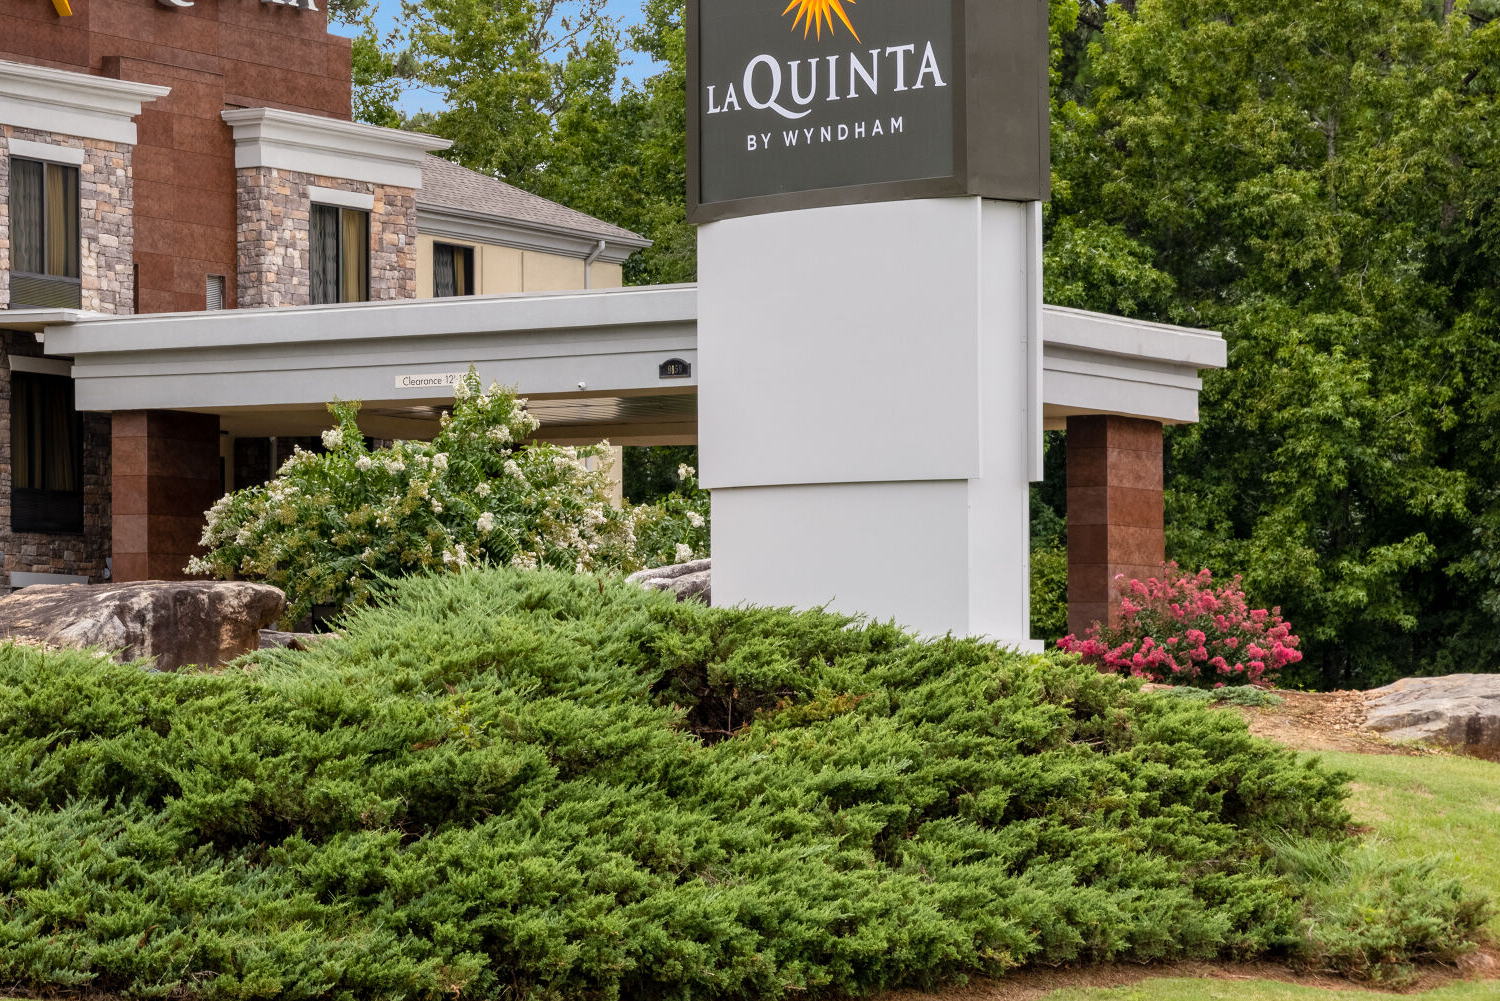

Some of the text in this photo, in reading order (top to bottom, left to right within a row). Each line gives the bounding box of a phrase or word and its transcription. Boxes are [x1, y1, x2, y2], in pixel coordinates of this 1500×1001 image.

[706, 40, 947, 120] LA QUINTA
[747, 116, 904, 151] BY WYNDHAM
[402, 376, 442, 386] Clearance
